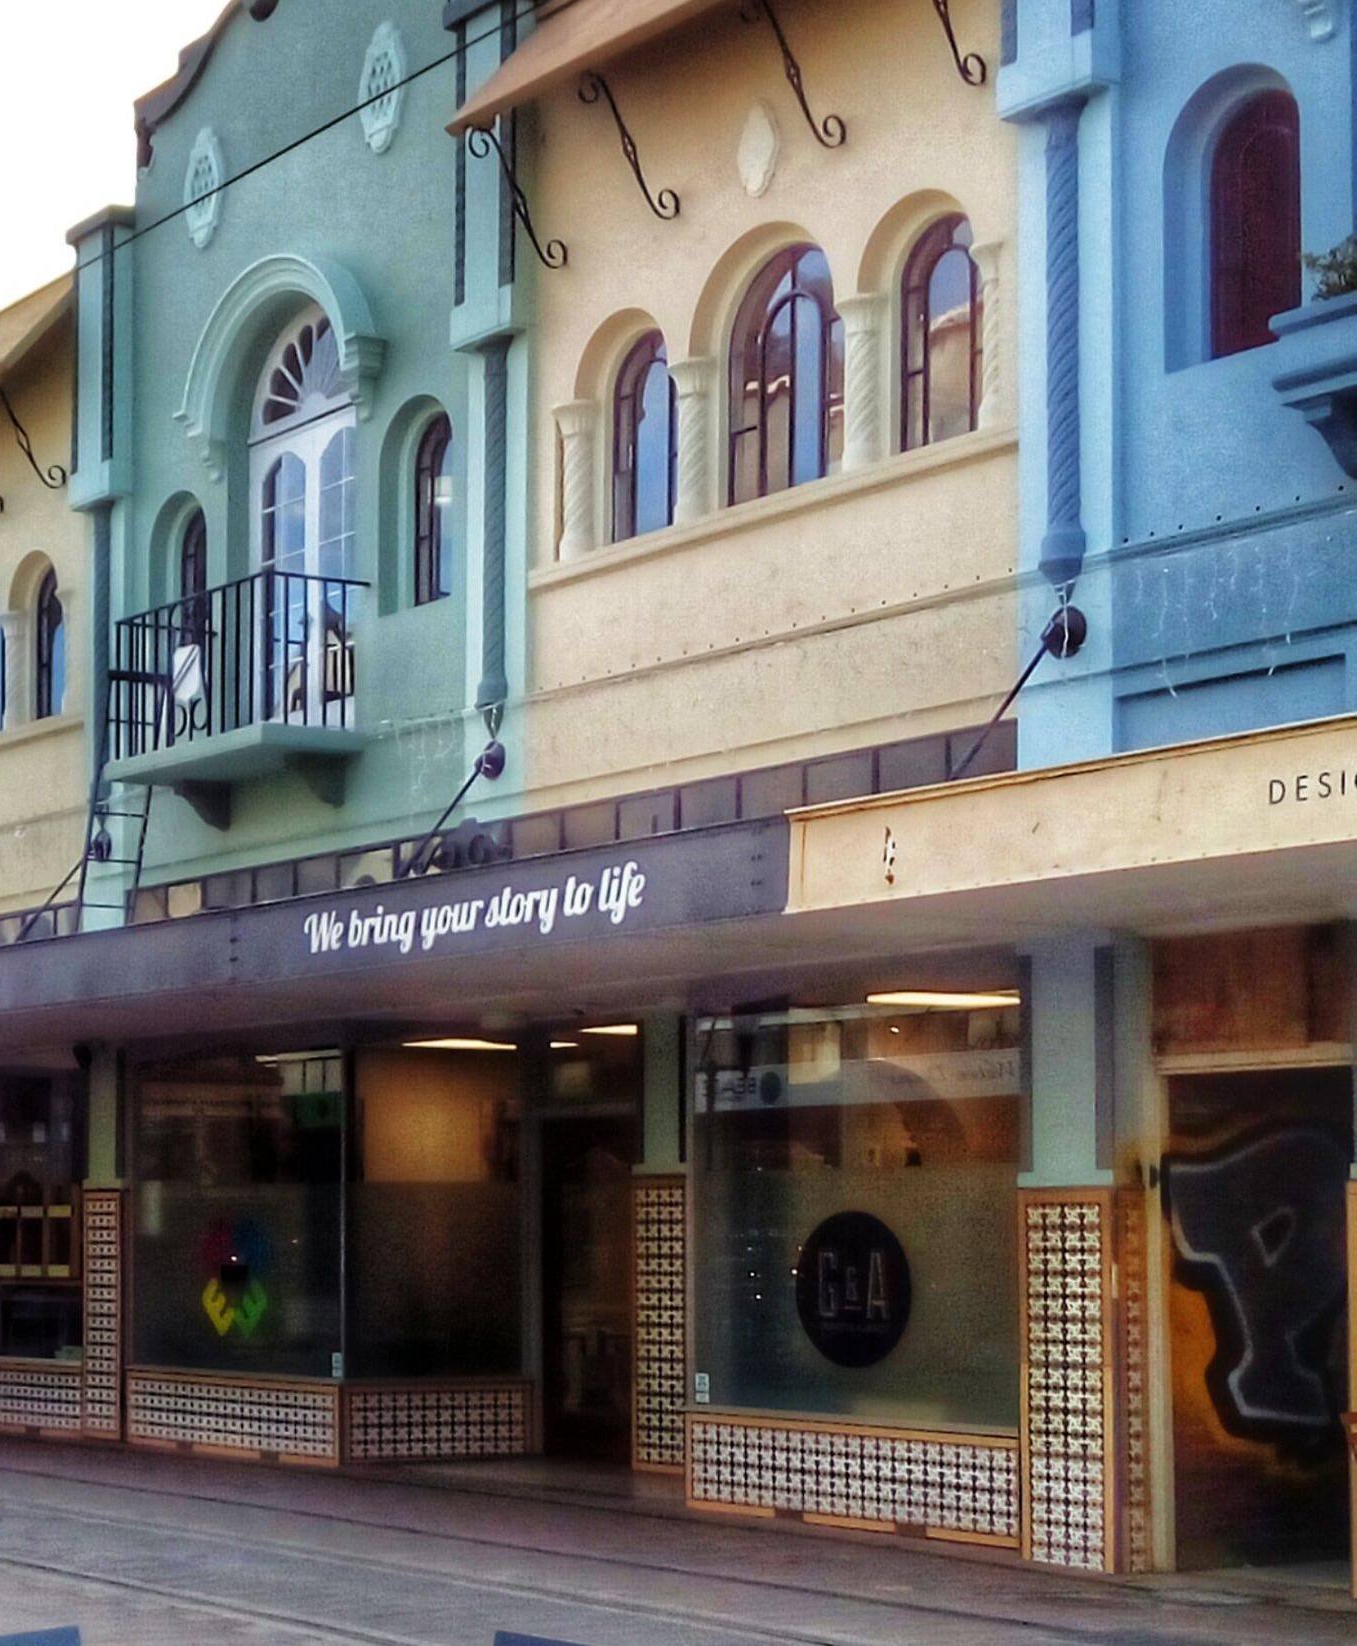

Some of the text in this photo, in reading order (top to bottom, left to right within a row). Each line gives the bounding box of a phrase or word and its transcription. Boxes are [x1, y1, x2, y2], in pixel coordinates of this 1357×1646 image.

[1269, 769, 1357, 804] DESI
[303, 861, 646, 954] We bring your story to life
